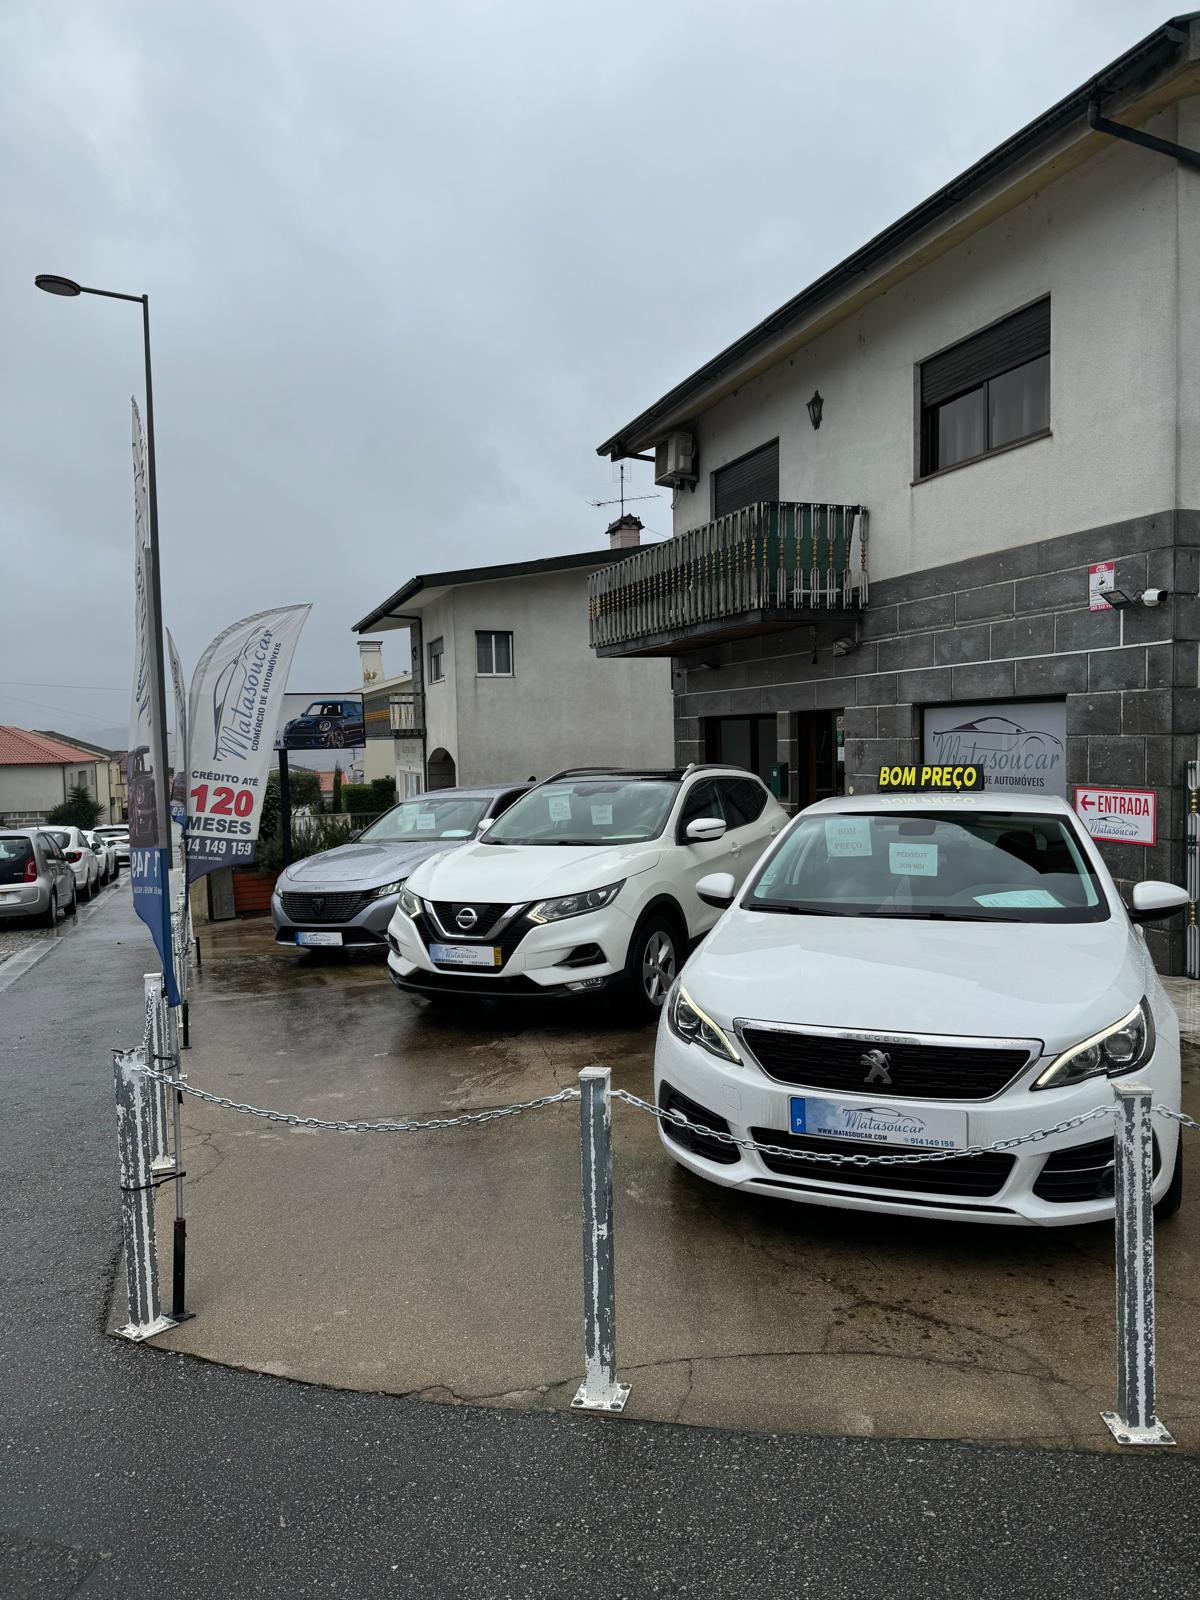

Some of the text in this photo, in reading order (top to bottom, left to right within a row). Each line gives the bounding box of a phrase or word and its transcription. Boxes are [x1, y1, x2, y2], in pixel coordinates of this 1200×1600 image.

[215, 629, 273, 762] Matasoucar
[251, 642, 282, 752] COMÉRCIO DE AUTOMÓVEIS
[932, 735, 1060, 770] Matasoucar
[191, 770, 259, 787] CRÉDITO ATÉ
[879, 766, 977, 790] BOM PREÇO
[994, 774, 1045, 787] AUTOMÓVEIS
[190, 783, 254, 817] 120
[1097, 795, 1150, 816] ENTRADA
[187, 815, 252, 835] MESES
[1088, 819, 1139, 836] Matasoucar
[187, 838, 252, 856] 14 149 159
[845, 1033, 911, 1044] PEUGEOT
[796, 1118, 803, 1126] P
[842, 1109, 924, 1134] Matasoucar
[817, 1127, 888, 1141] WWW.MATASOUCAR.COM
[910, 1137, 955, 1147] 914 149 159
